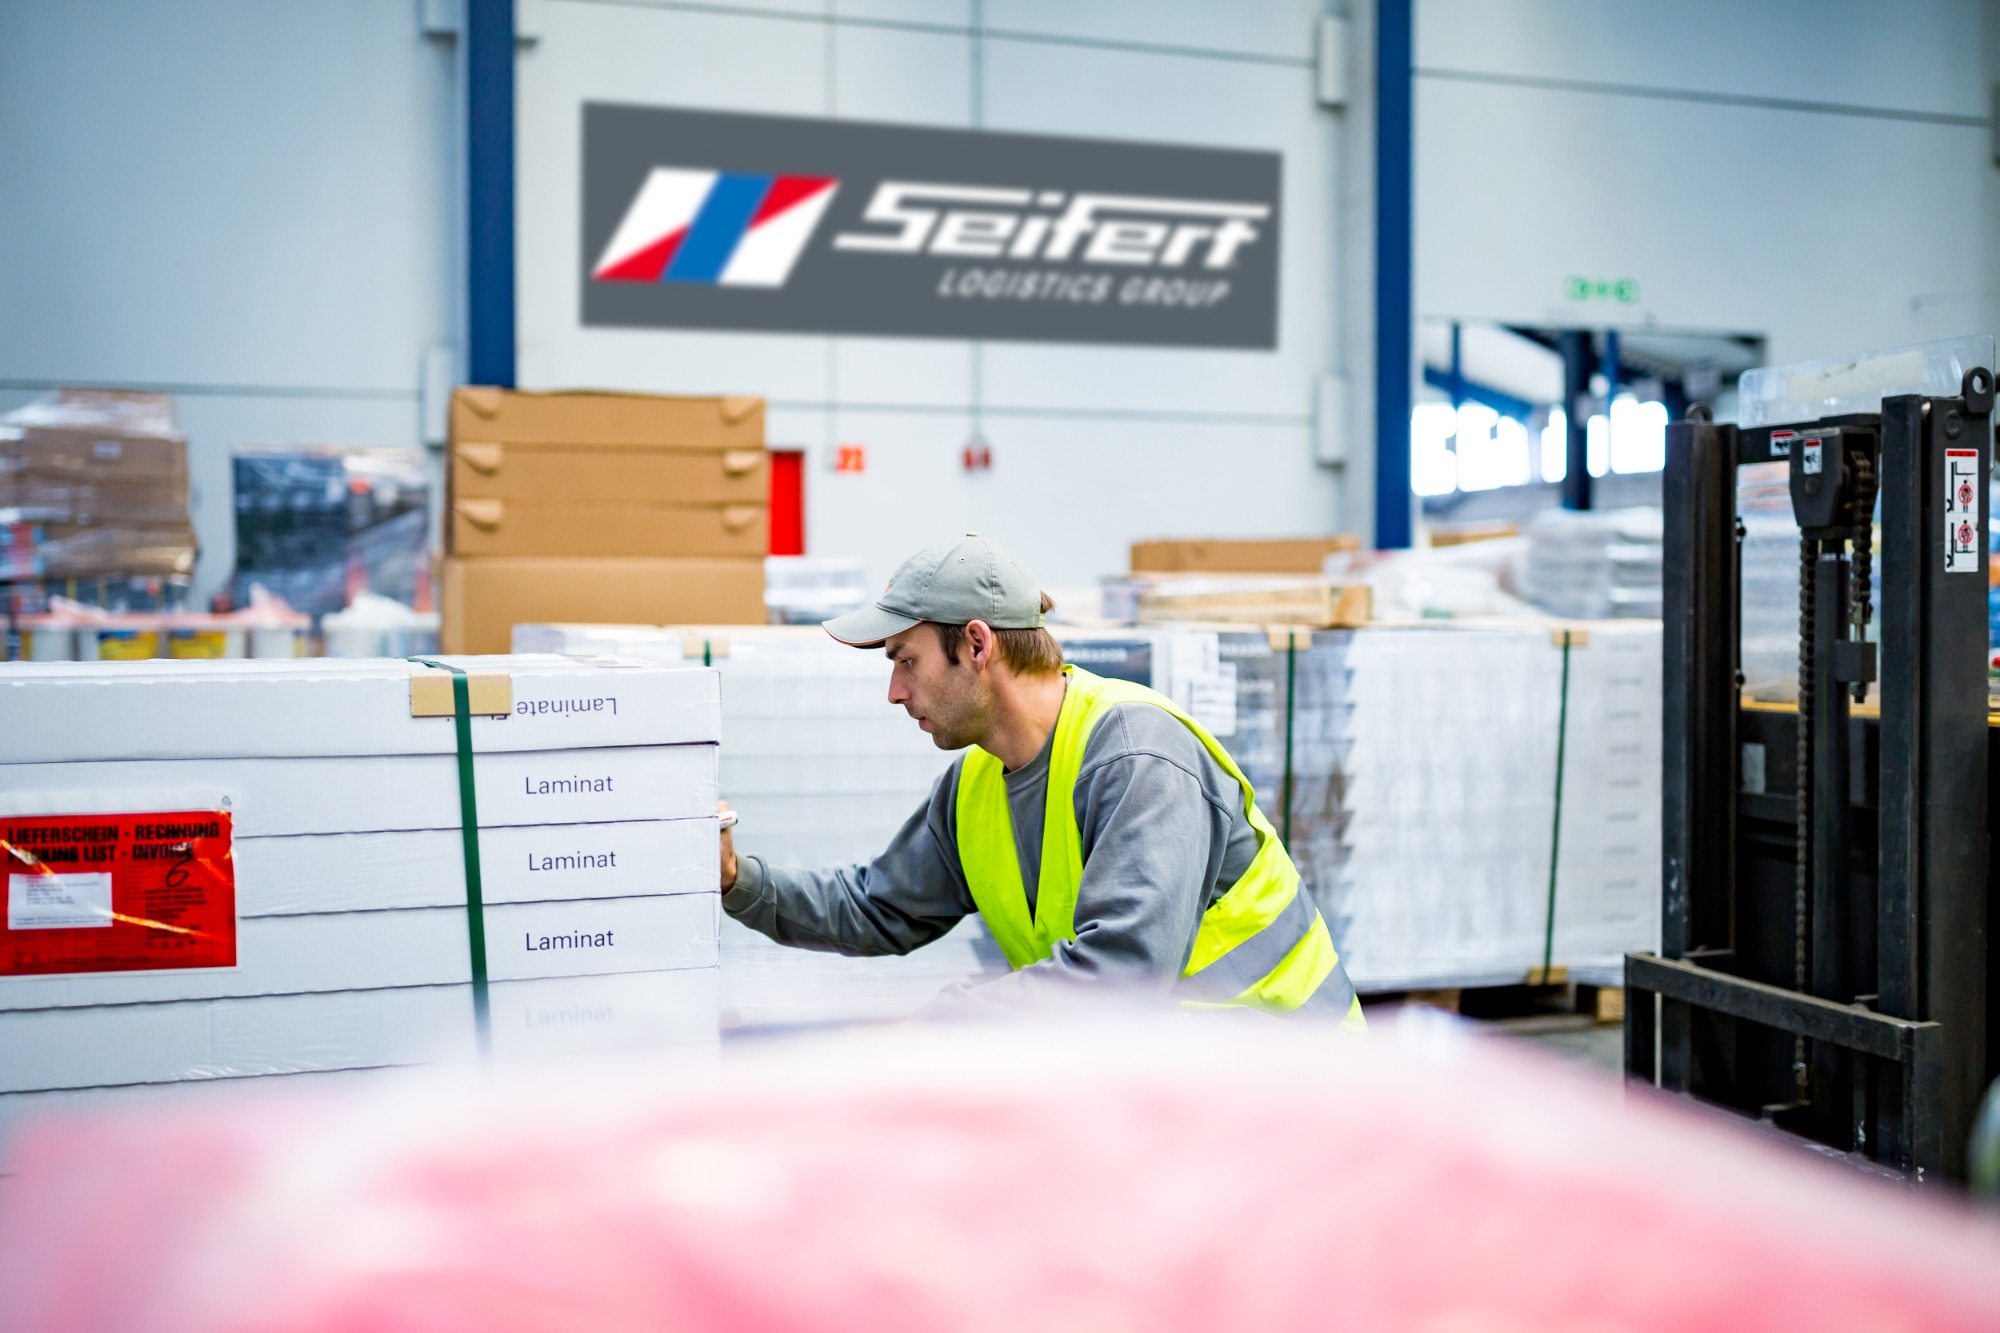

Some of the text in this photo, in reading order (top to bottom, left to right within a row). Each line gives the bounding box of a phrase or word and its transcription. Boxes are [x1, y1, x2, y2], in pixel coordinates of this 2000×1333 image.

[832, 181, 1271, 268] Seifert
[937, 268, 1231, 307] LOGISTICS GROUP
[517, 698, 617, 717] Laminate
[525, 775, 614, 795] Laminat
[8, 825, 119, 844] LIEFERSCHEIN
[135, 822, 220, 841] RECHNUNG
[83, 845, 116, 862] LIST
[529, 850, 617, 871] Laminat
[165, 857, 193, 888] 6
[525, 930, 615, 951] Laminat
[524, 1006, 615, 1028] Laminat
